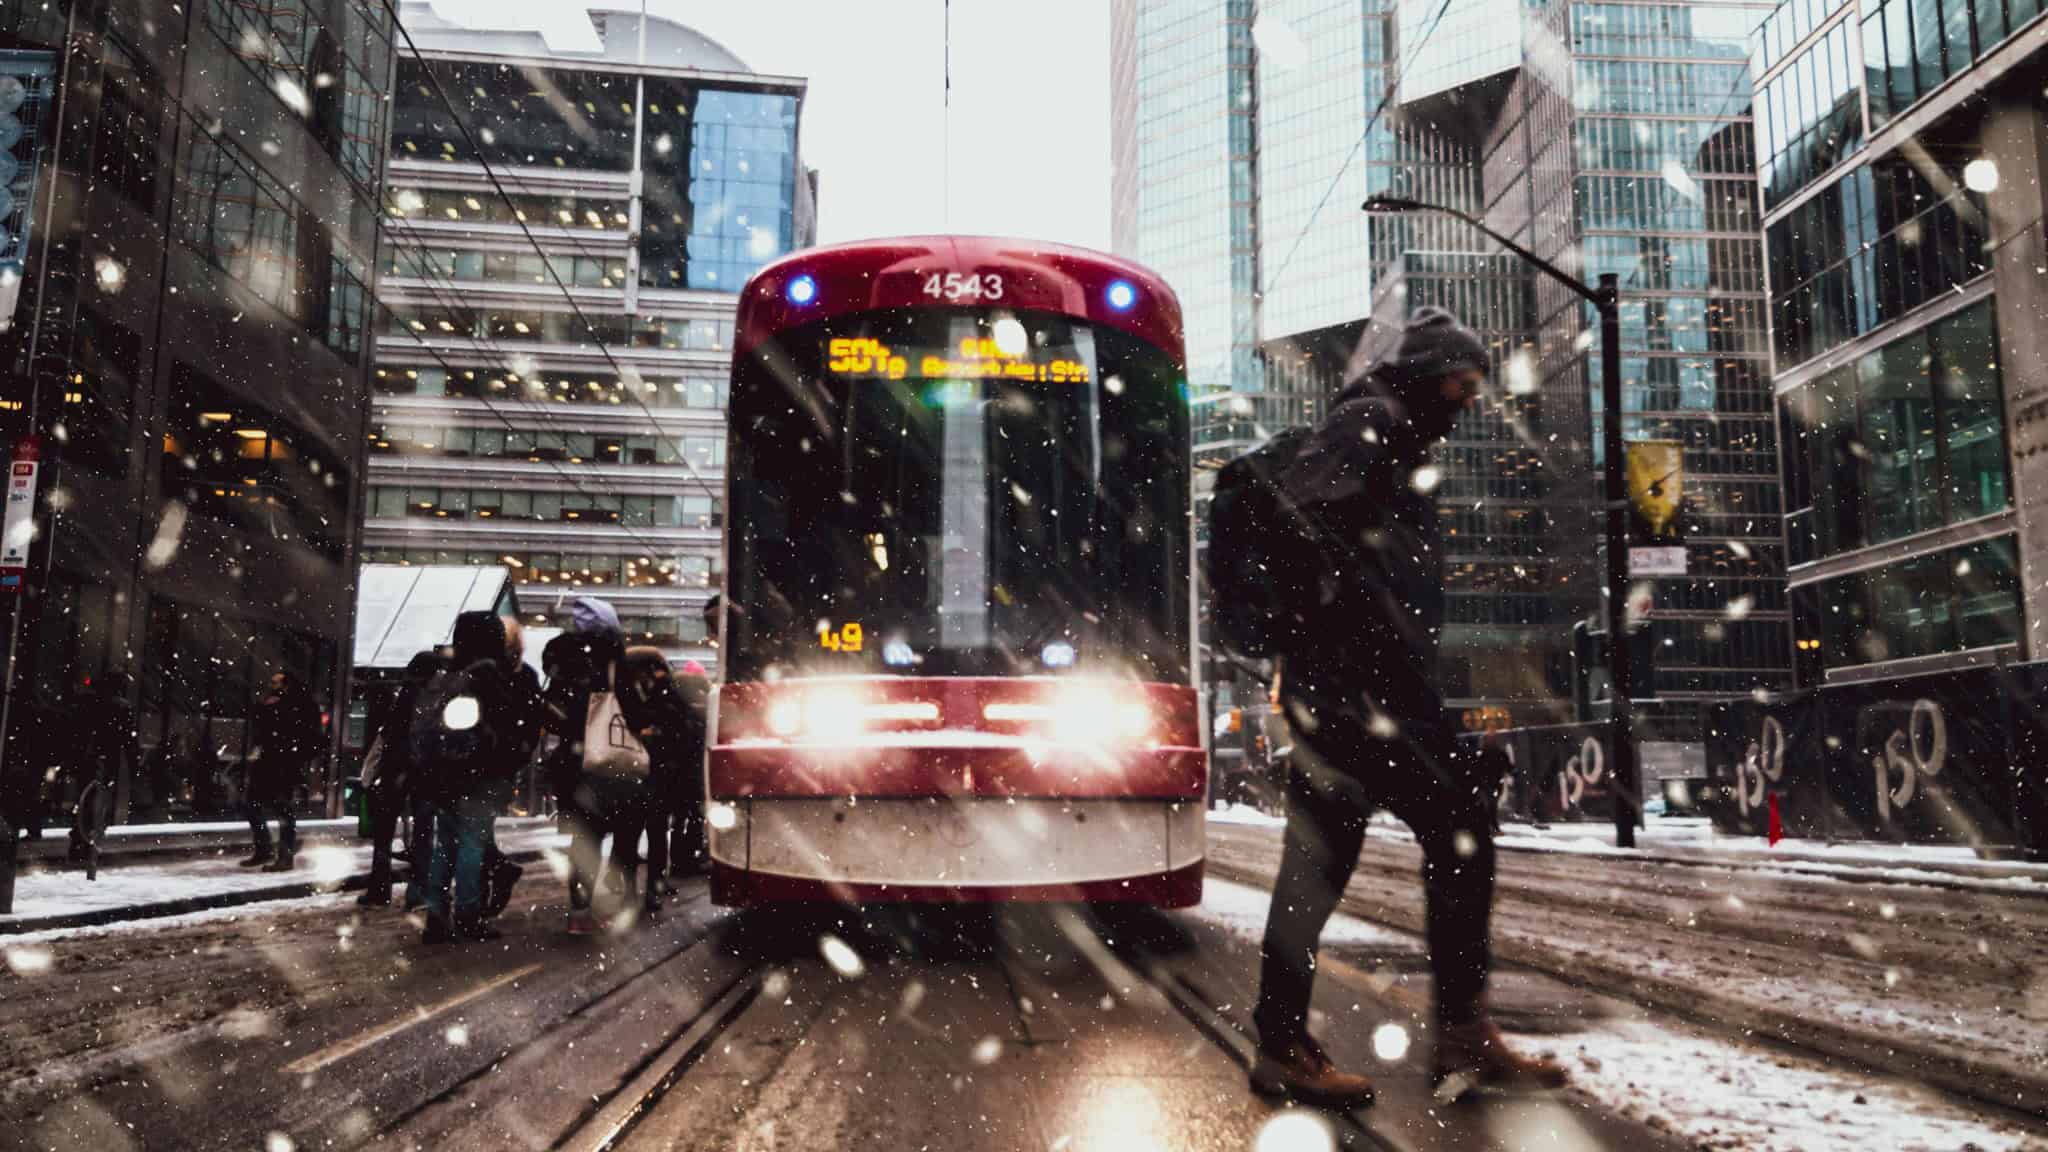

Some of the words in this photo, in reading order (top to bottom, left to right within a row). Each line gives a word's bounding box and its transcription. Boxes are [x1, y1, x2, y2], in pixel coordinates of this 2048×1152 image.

[923, 274, 1002, 299] 4543
[820, 621, 863, 652] 49
[1559, 736, 1603, 810] 150
[1737, 715, 1784, 816] 150
[1872, 699, 1947, 821] 150
